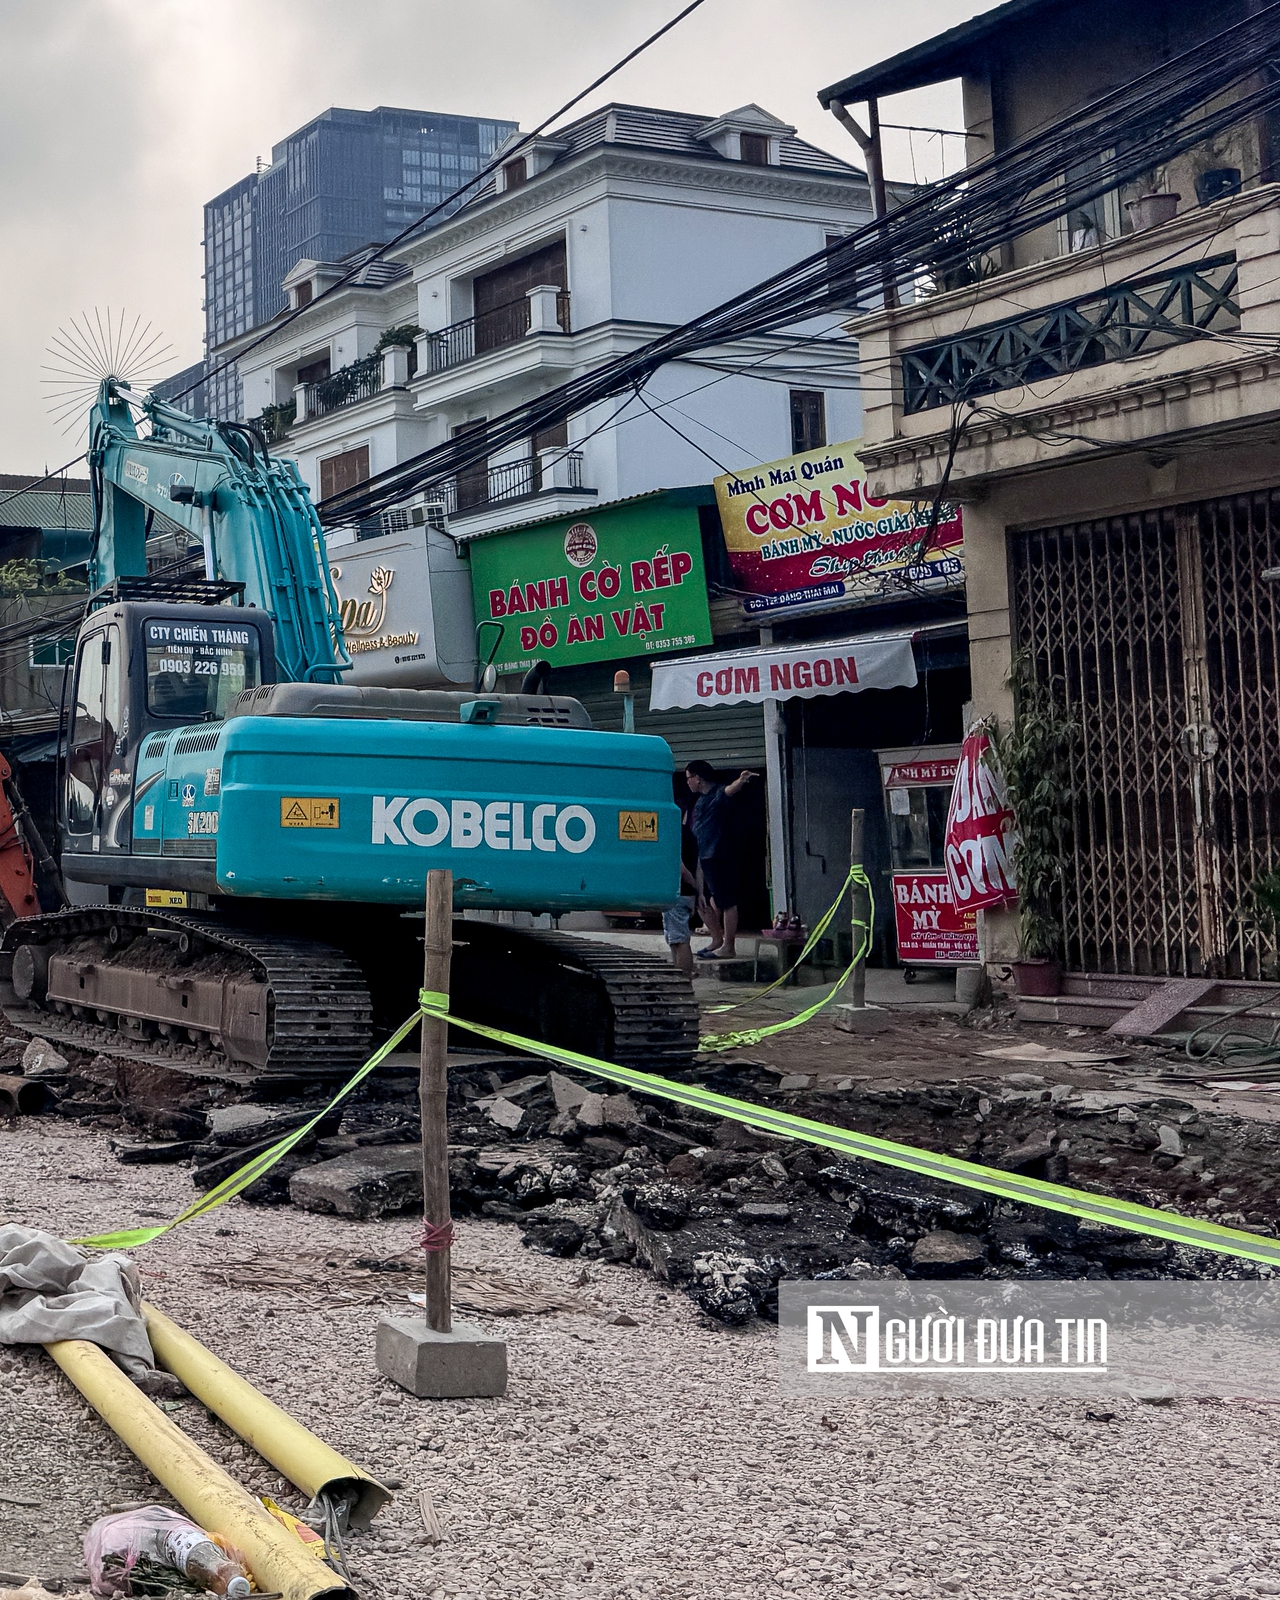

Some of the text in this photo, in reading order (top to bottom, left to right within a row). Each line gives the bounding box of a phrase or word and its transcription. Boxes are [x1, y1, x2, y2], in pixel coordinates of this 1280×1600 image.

[727, 456, 844, 497] Minh Mai Quán
[746, 489, 826, 535] CƠM
[761, 539, 799, 560] BÁNH
[832, 521, 874, 545] NƯỚC
[489, 544, 693, 619] BÁNH CỜ RẾP
[150, 626, 171, 640] CTY
[173, 625, 209, 643] CHIẾN
[387, 631, 419, 647] Beauty
[520, 601, 665, 651] ĐỒ ĂN VẶT
[160, 659, 191, 673] 0903
[194, 662, 218, 675] 226
[696, 656, 859, 697] CƠM NGON
[187, 811, 219, 834] SK200
[371, 796, 596, 854] KOBELCO
[896, 879, 953, 904] BÁNH
